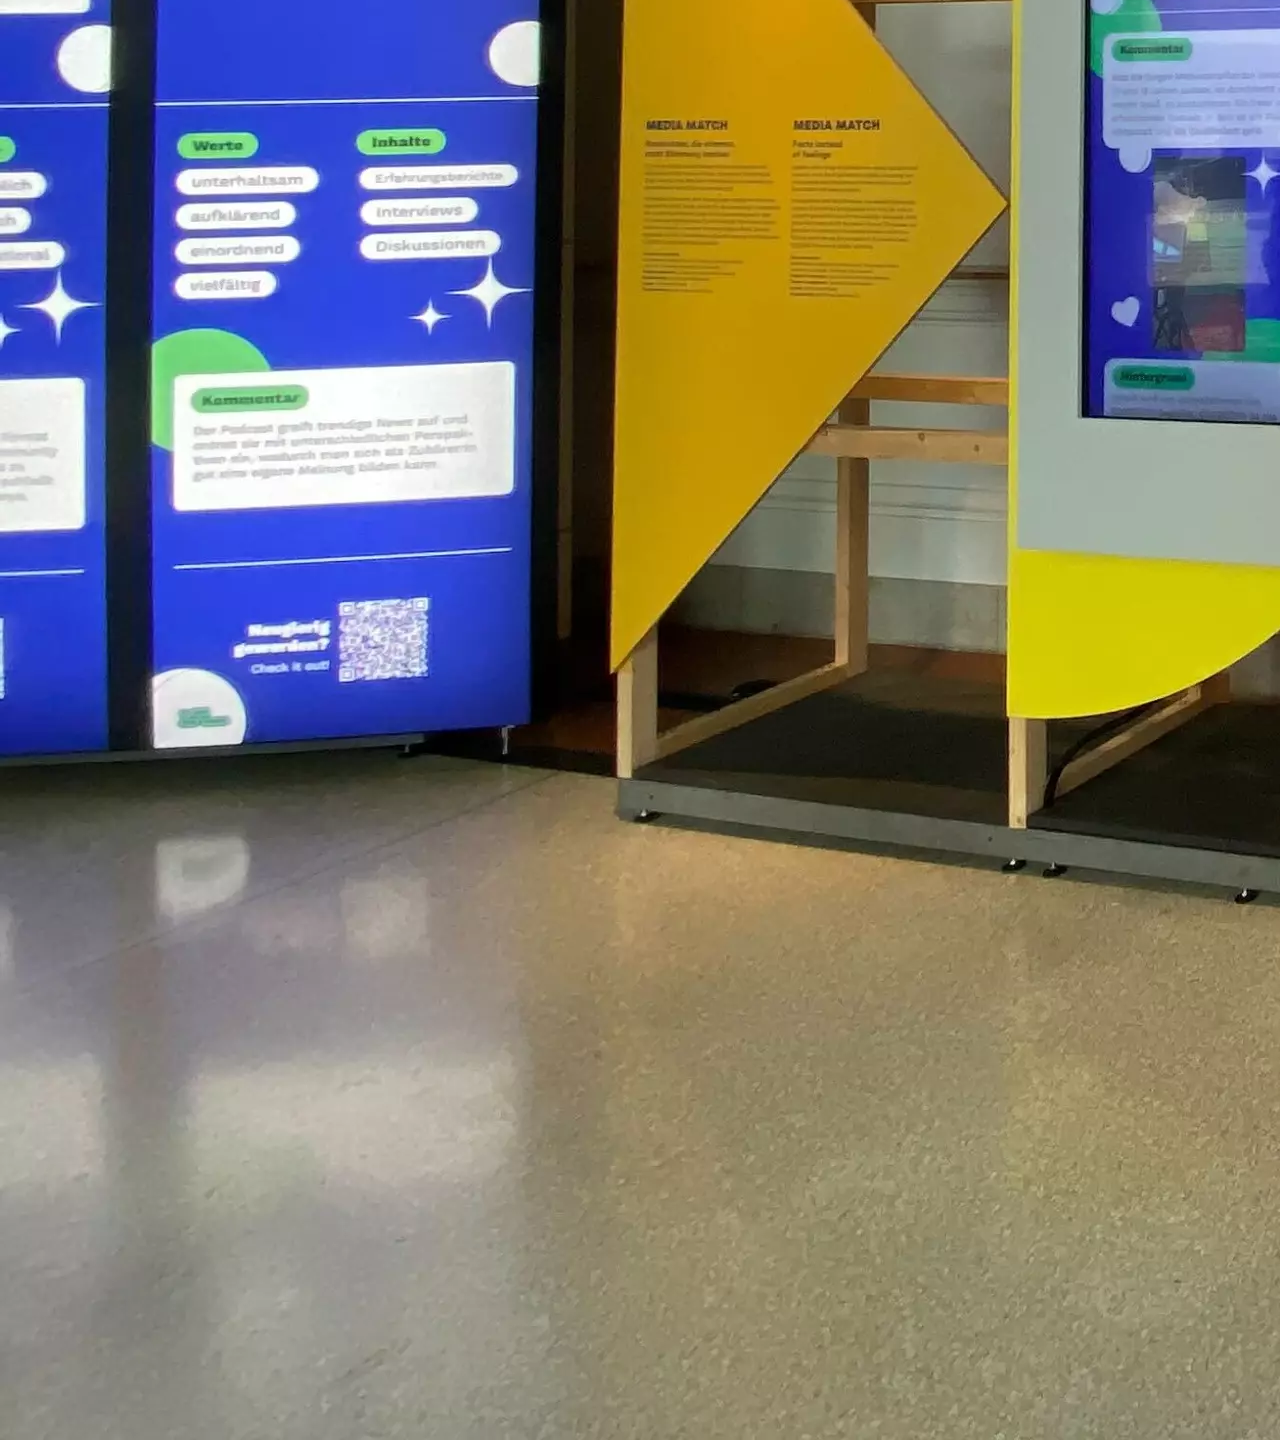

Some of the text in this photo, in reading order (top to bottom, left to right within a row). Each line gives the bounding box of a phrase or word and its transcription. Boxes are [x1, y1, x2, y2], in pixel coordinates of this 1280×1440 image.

[646, 120, 728, 131] MEDIA MATCH
[793, 120, 880, 131] MEDIA MATCH
[191, 173, 303, 188] unterhaltsam
[376, 205, 463, 218] Interviews
[376, 238, 486, 253] Diskussionen
